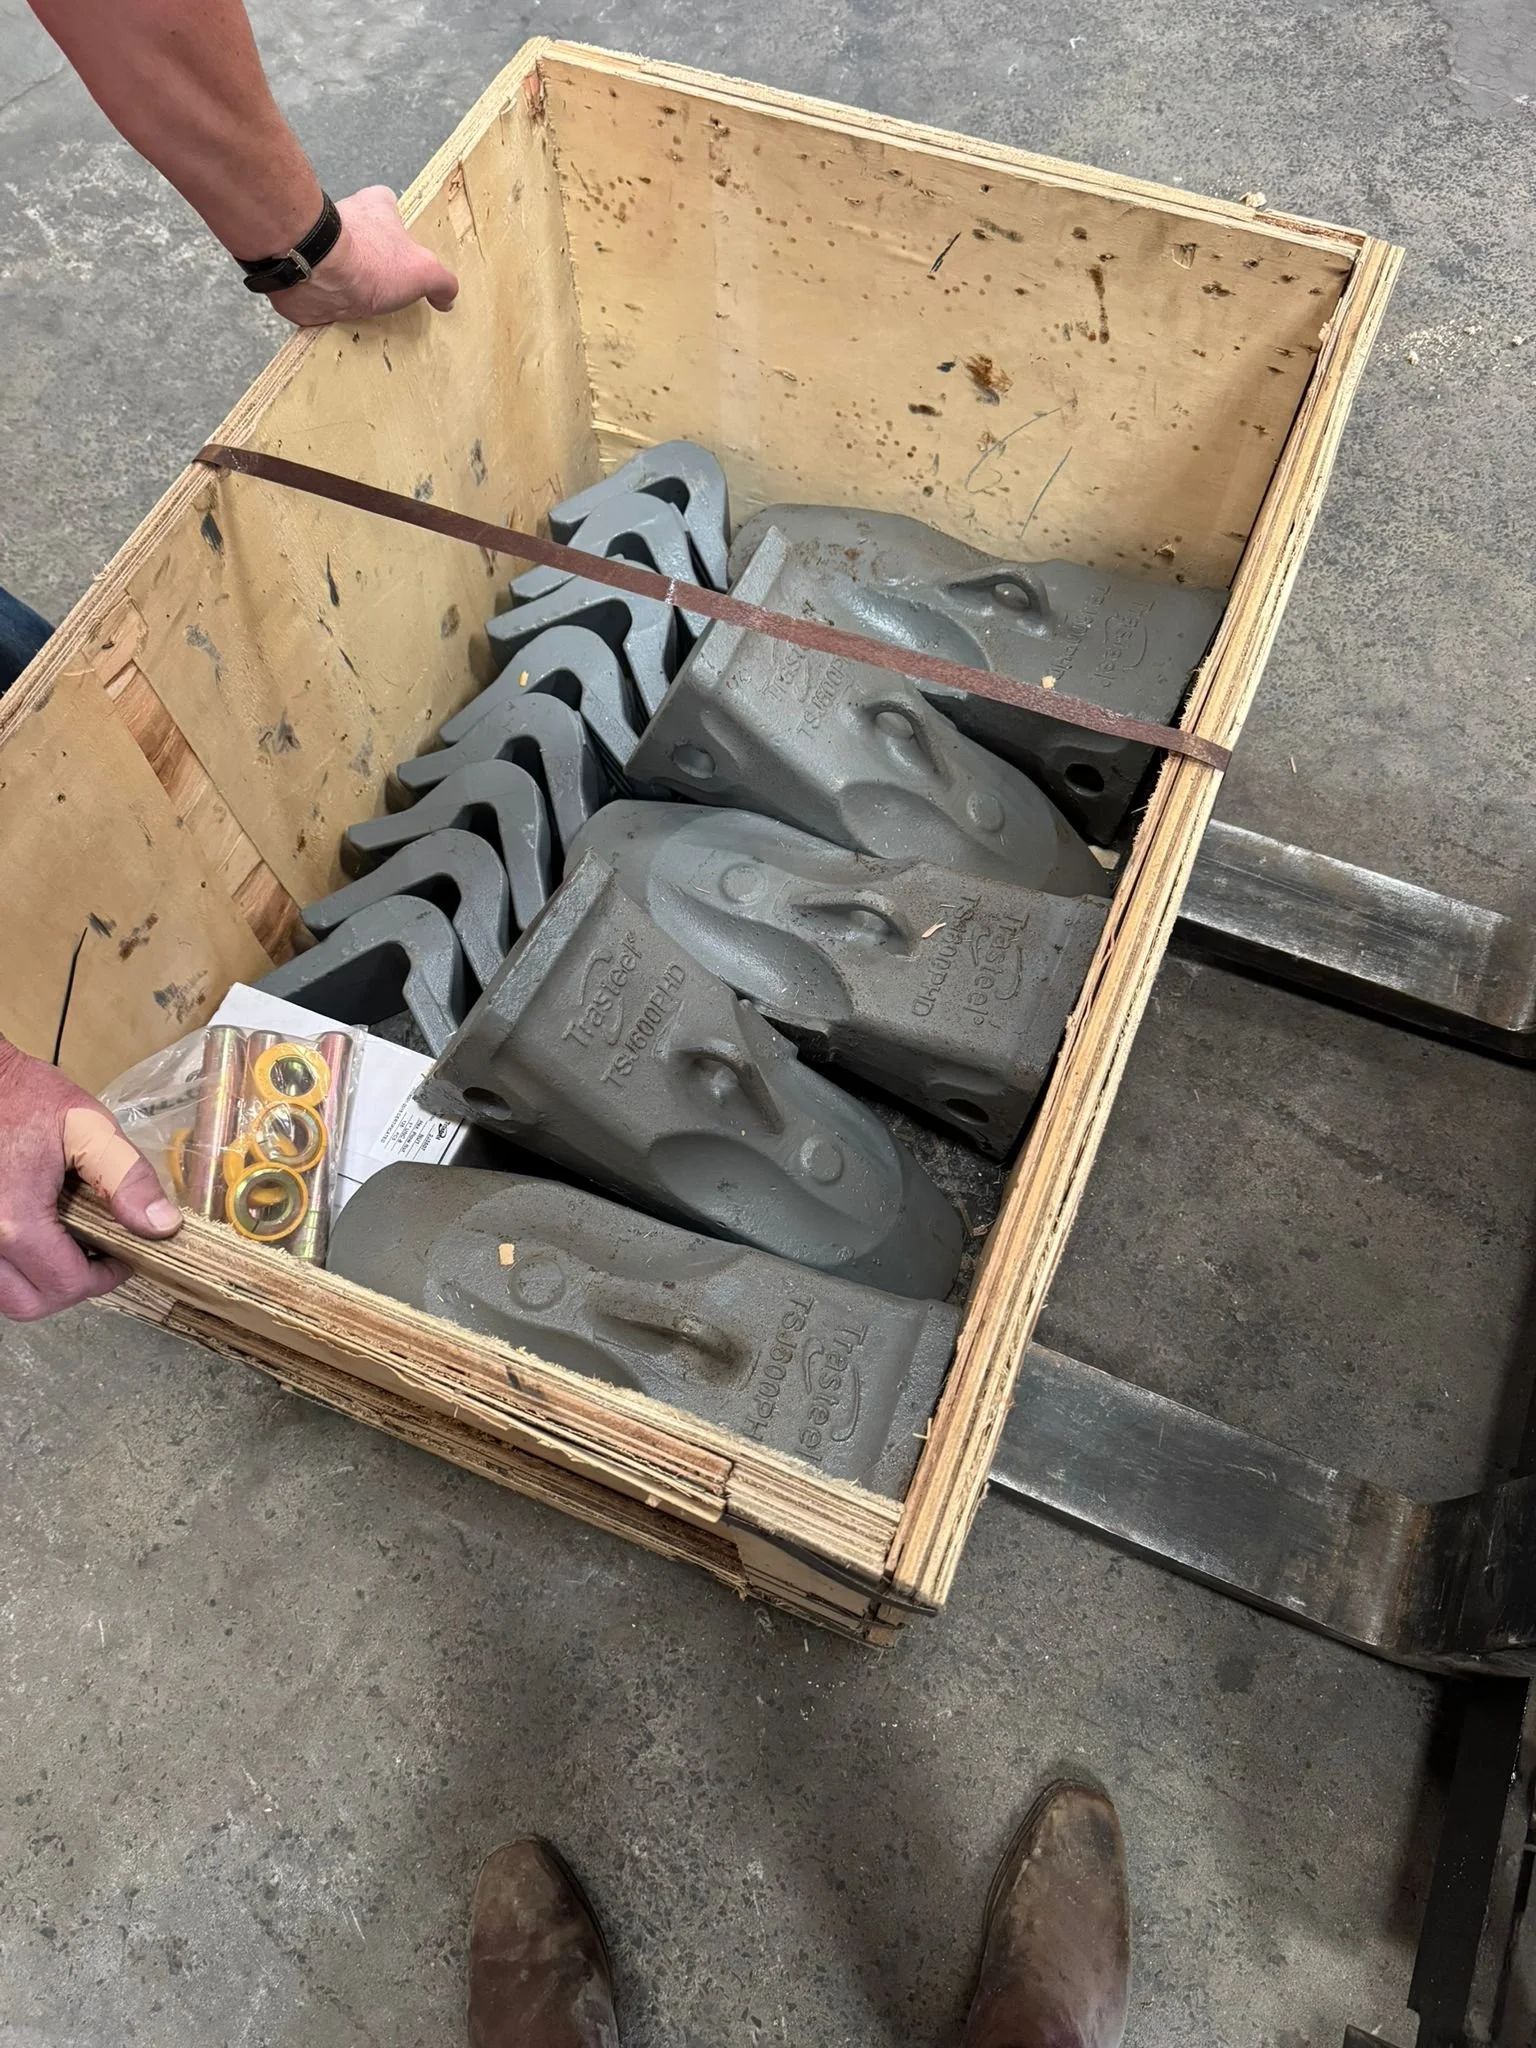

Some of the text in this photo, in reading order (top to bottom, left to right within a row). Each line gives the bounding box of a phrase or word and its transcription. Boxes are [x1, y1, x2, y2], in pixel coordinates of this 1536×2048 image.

[561, 938, 643, 1048] Trasteel
[600, 961, 686, 1088] TSJ600PHD
[962, 914, 1029, 1016] Trasteel
[743, 1298, 815, 1442] TSJ600PH
[795, 1325, 868, 1461] Trasteel
